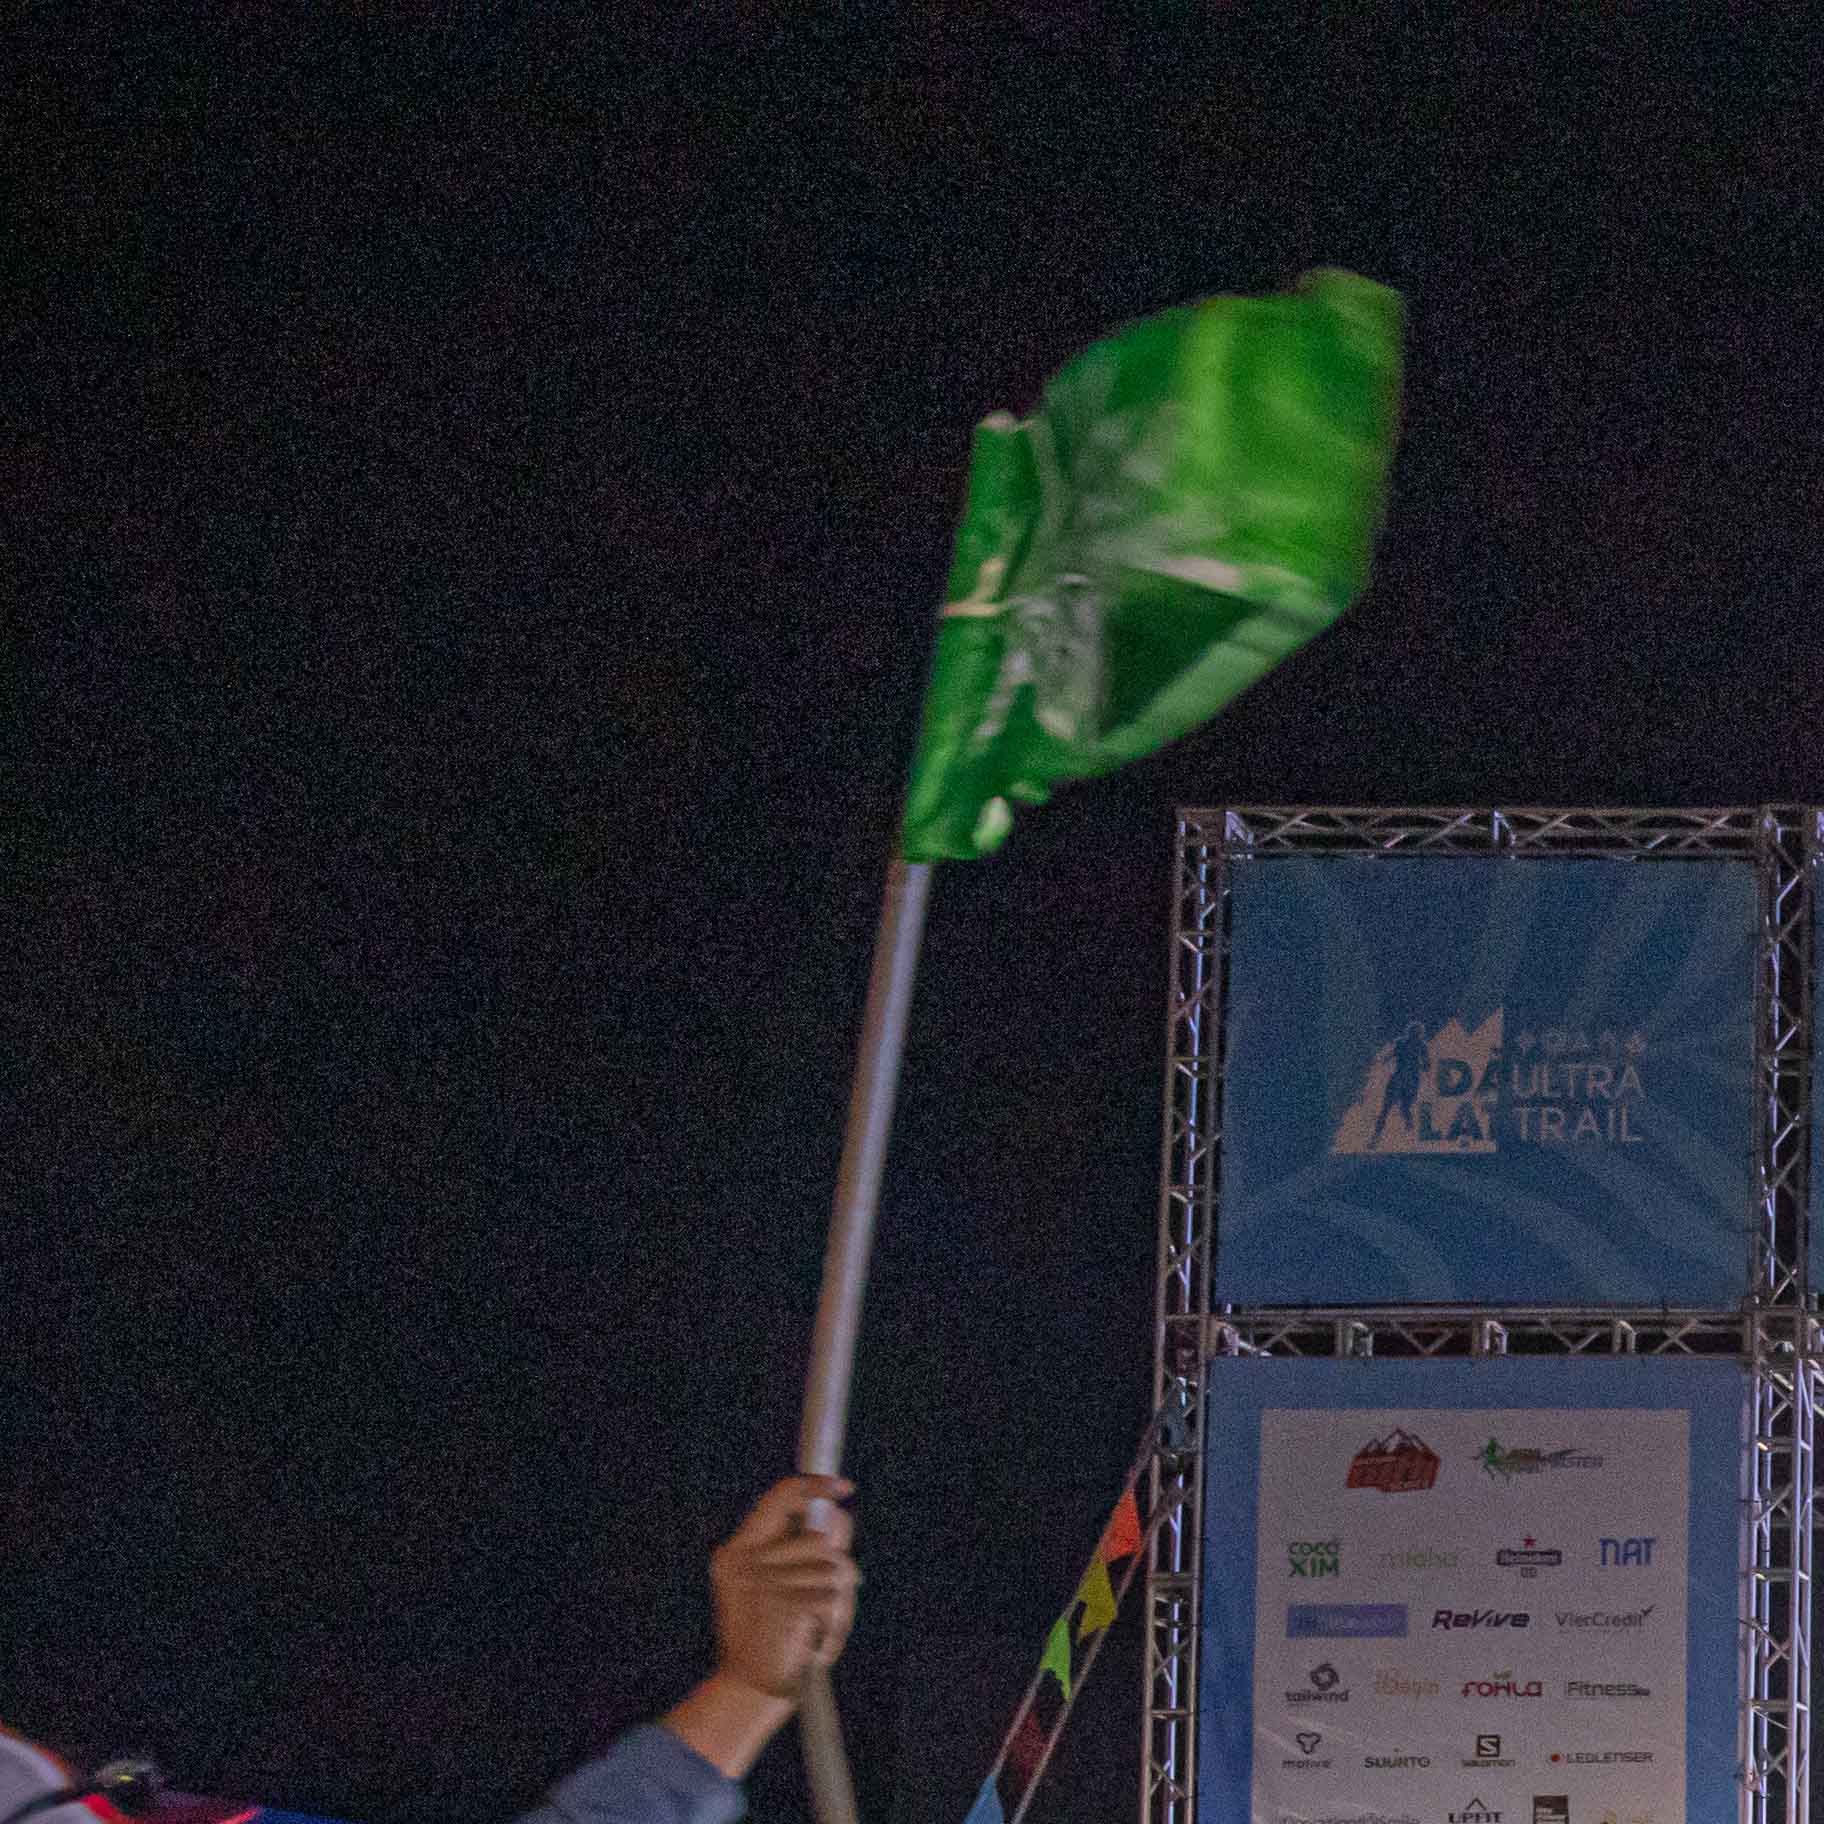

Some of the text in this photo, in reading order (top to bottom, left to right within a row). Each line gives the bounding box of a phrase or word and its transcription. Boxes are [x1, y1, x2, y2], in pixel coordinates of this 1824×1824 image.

[1512, 1062, 1645, 1098] ULTRA
[1514, 1106, 1643, 1143] TRAIL
[1288, 1558, 1340, 1579] XIM
[1364, 1755, 1431, 1769] SUUNTO
